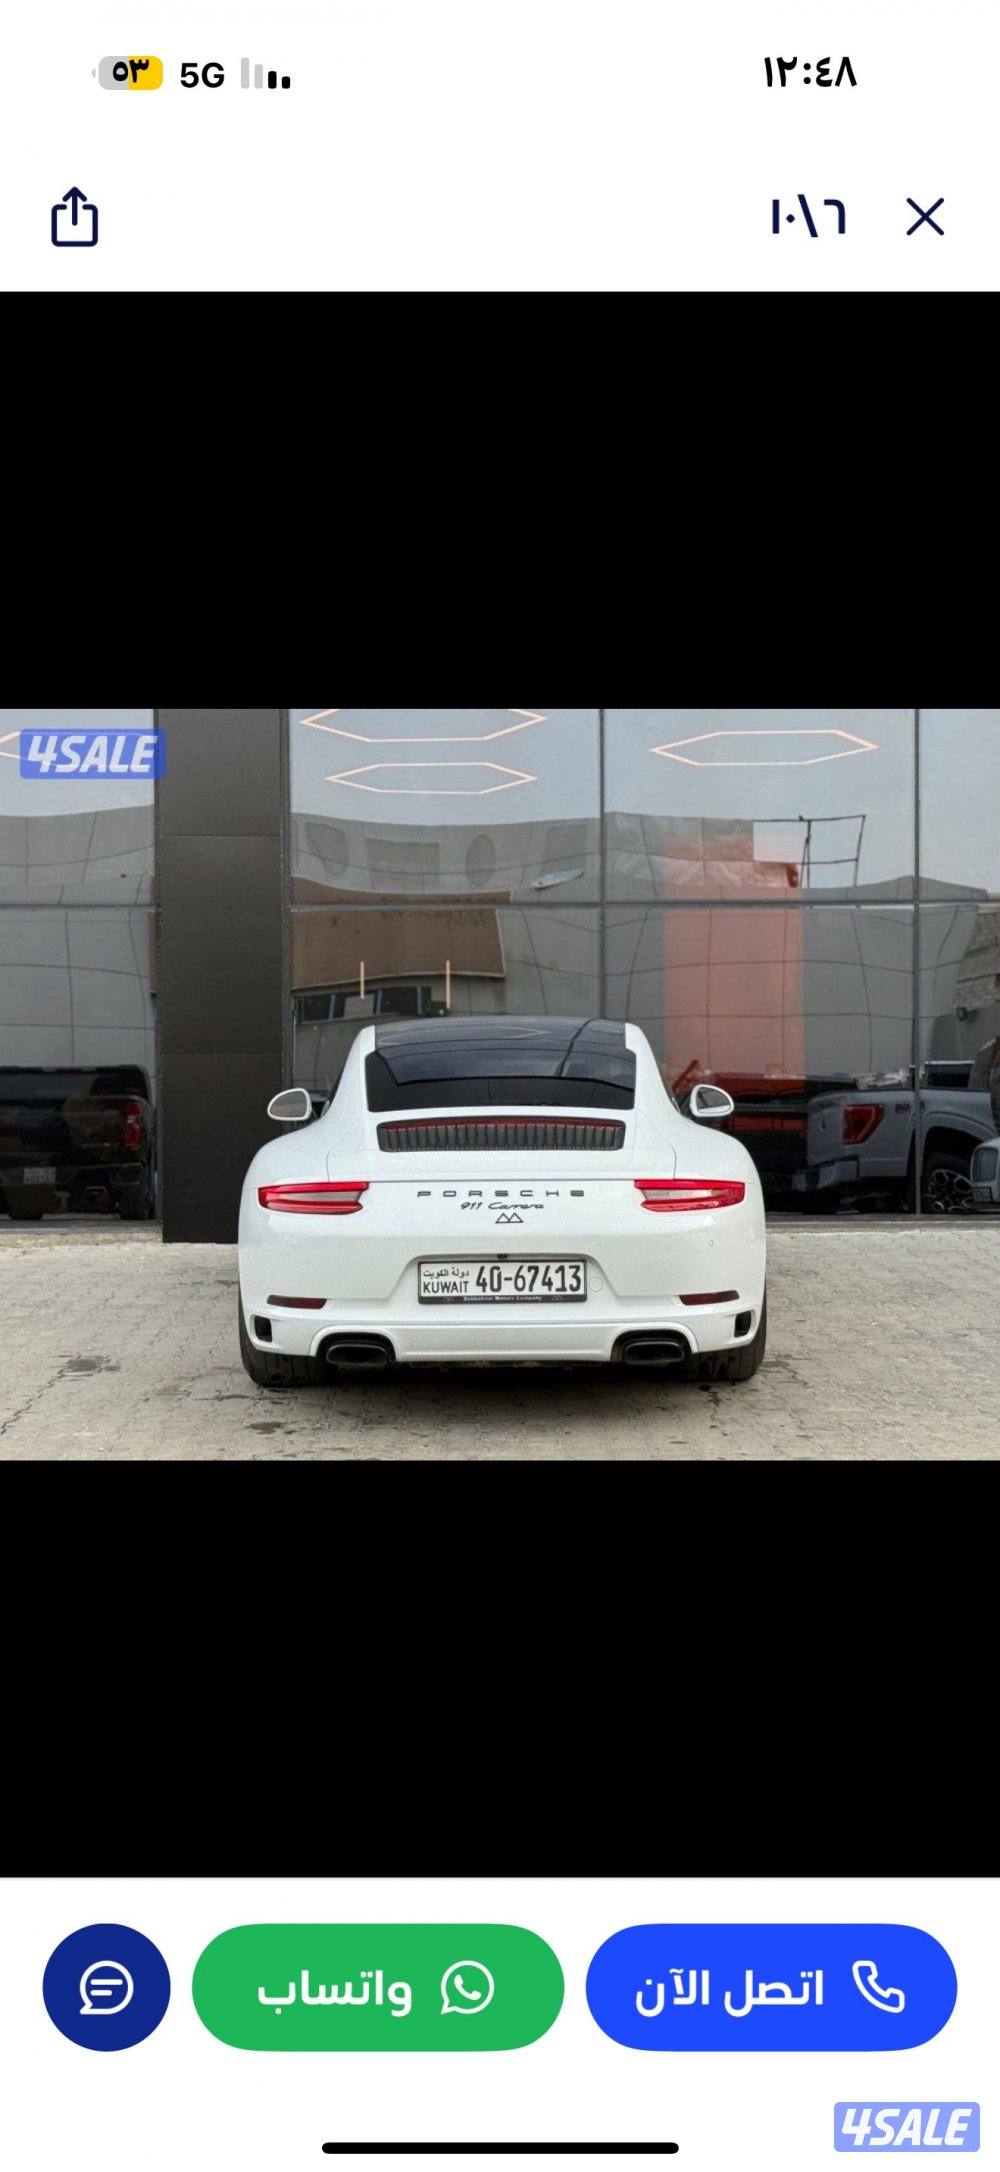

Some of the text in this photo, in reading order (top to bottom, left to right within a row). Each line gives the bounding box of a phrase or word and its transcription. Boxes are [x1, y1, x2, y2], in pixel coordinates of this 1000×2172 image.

[112, 58, 150, 83] ٥٣
[180, 62, 225, 89] 5G
[764, 56, 858, 88] ١٢:٤٨
[417, 1189, 585, 1198] PORSCHE
[461, 1201, 545, 1210] 911 Carrera
[423, 1266, 470, 1279] دولة الكويت
[475, 1264, 582, 1293] 40-67413
[423, 1280, 470, 1294] KUWAIT
[258, 1969, 412, 2018] واتساب
[635, 1968, 823, 2018] اتصل الآن
